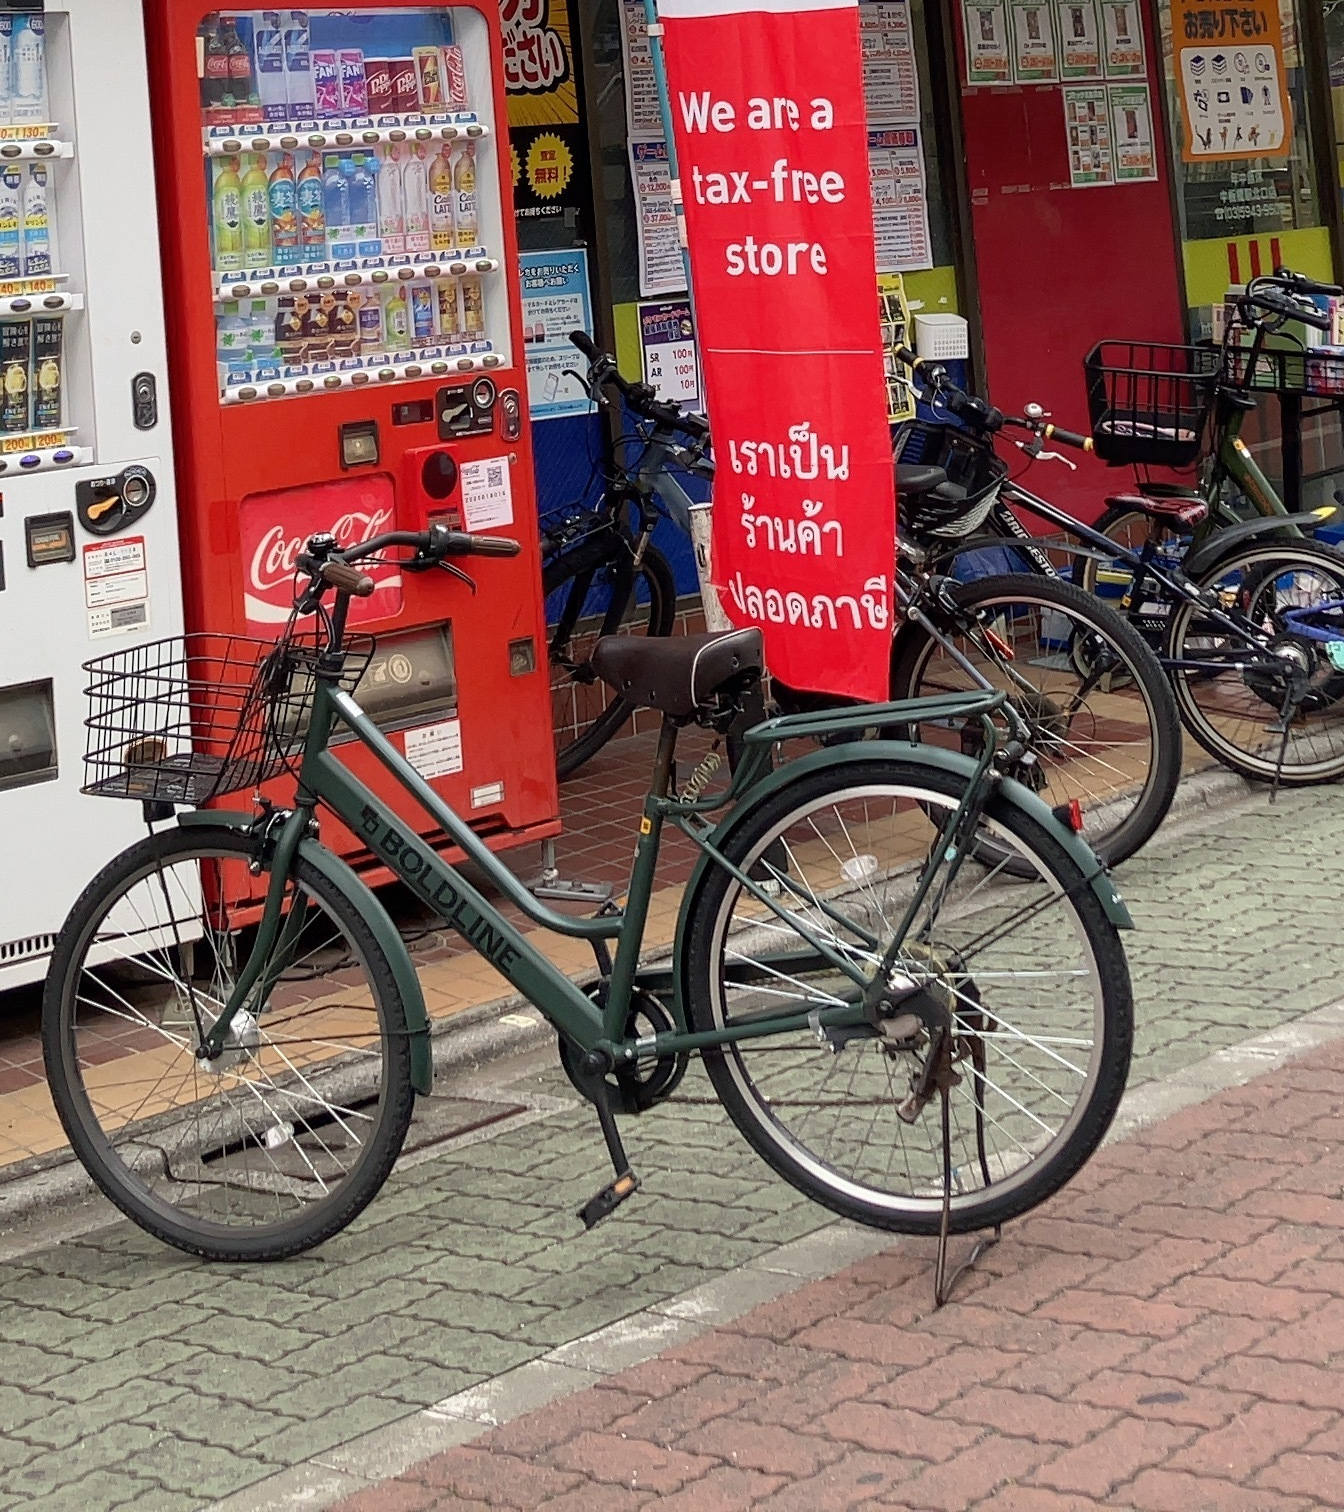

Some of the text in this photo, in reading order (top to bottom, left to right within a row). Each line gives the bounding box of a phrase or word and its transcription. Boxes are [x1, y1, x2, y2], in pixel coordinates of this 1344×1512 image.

[1183, 8, 1268, 39] お売り下さい
[679, 90, 834, 134] We are a
[692, 158, 846, 205] tax-free
[726, 236, 828, 276] store
[649, 352, 660, 363] SR
[651, 368, 663, 377] AR
[729, 420, 850, 482] เราเป็น
[740, 493, 844, 558] ร้านค้า
[379, 829, 522, 974] BOLDLINE
